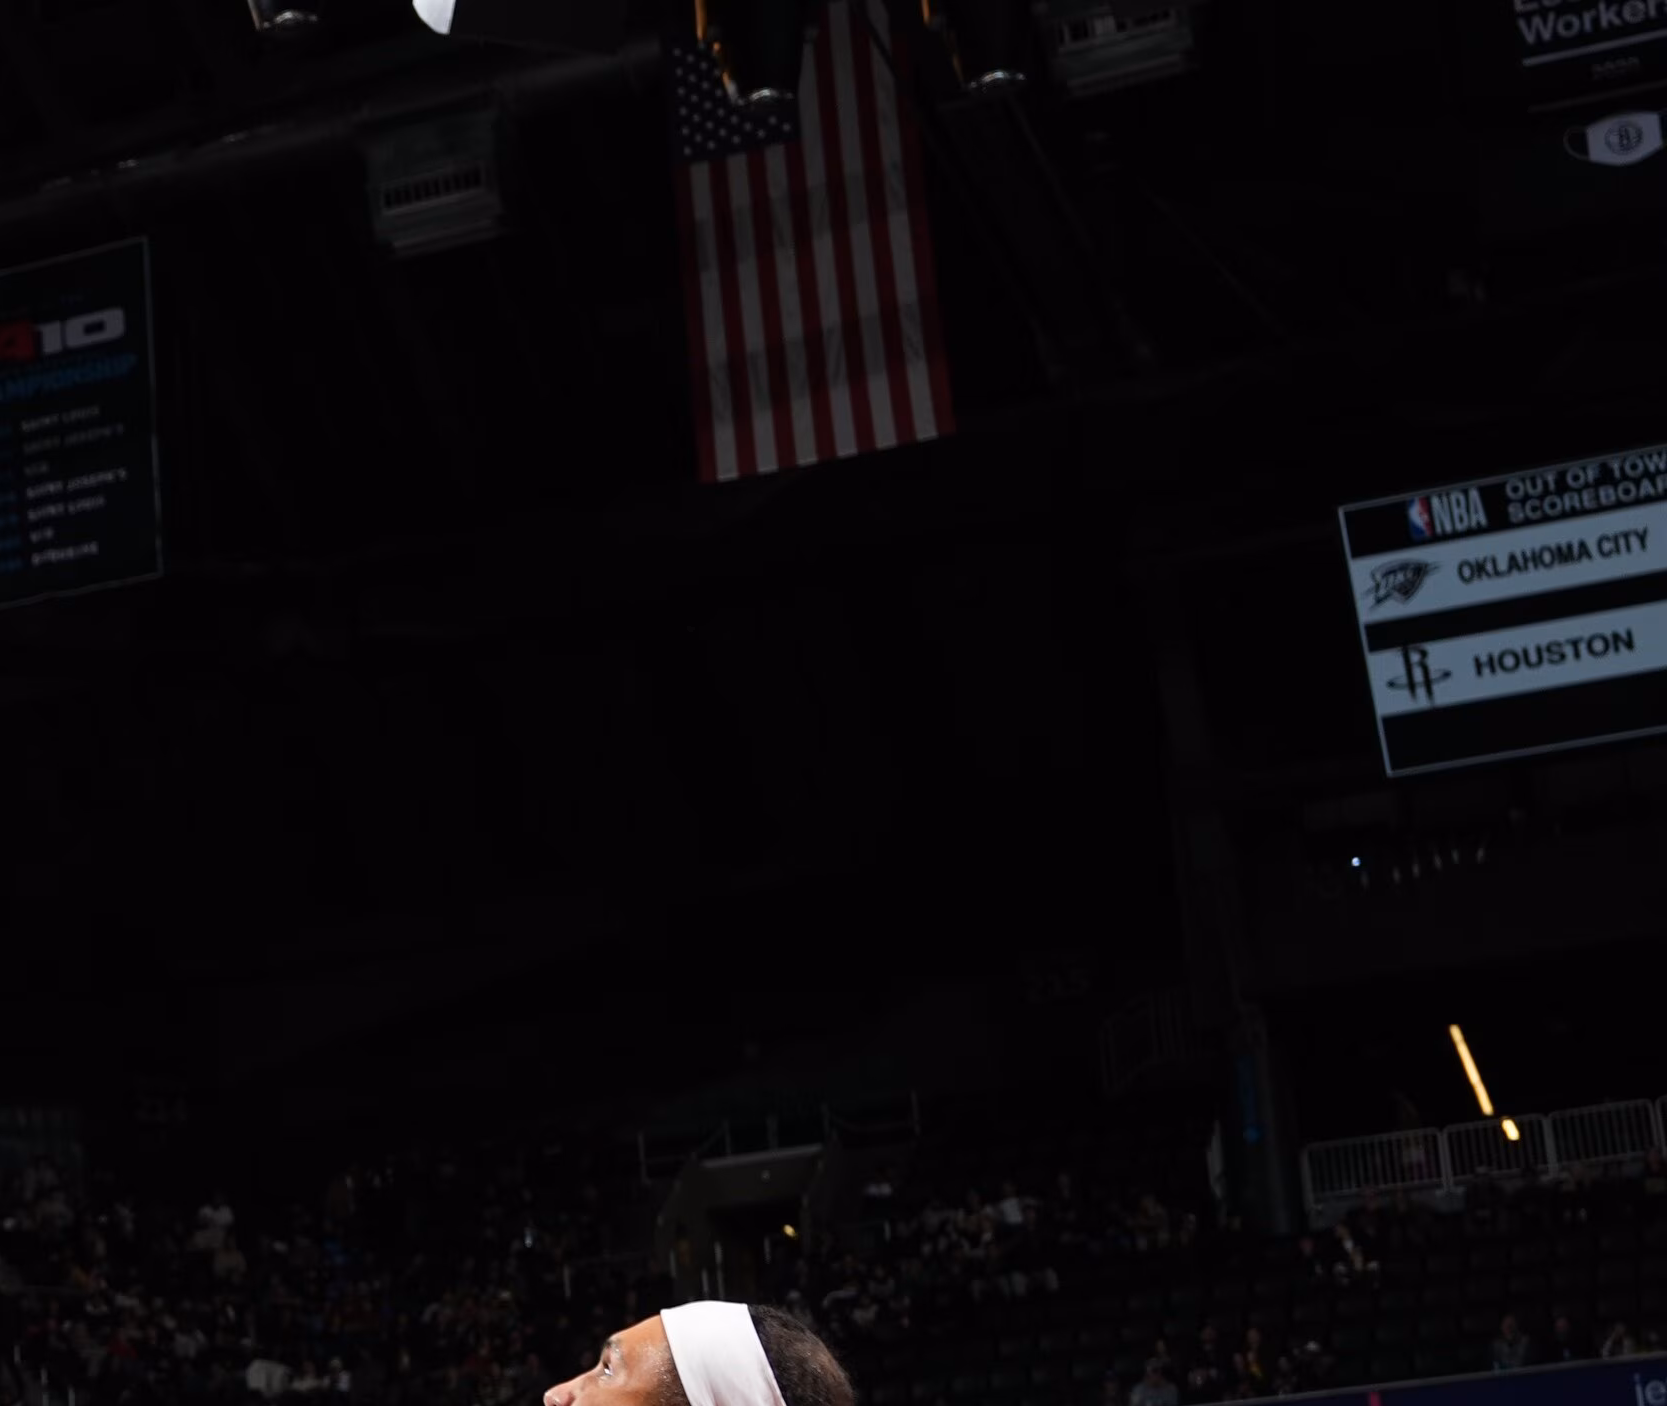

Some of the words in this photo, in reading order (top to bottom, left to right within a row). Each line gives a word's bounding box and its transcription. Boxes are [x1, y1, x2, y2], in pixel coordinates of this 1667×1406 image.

[1517, 0, 1667, 46] Worker
[1506, 474, 1559, 500] OUT
[1566, 464, 1601, 490] OF
[1613, 449, 1667, 481] TOW
[1431, 487, 1489, 537] NBA
[1506, 478, 1667, 526] SCOREBOA
[1457, 538, 1593, 585] OKLAHOMA
[1597, 527, 1651, 560] CITY
[1473, 628, 1635, 678] HOUSTON
